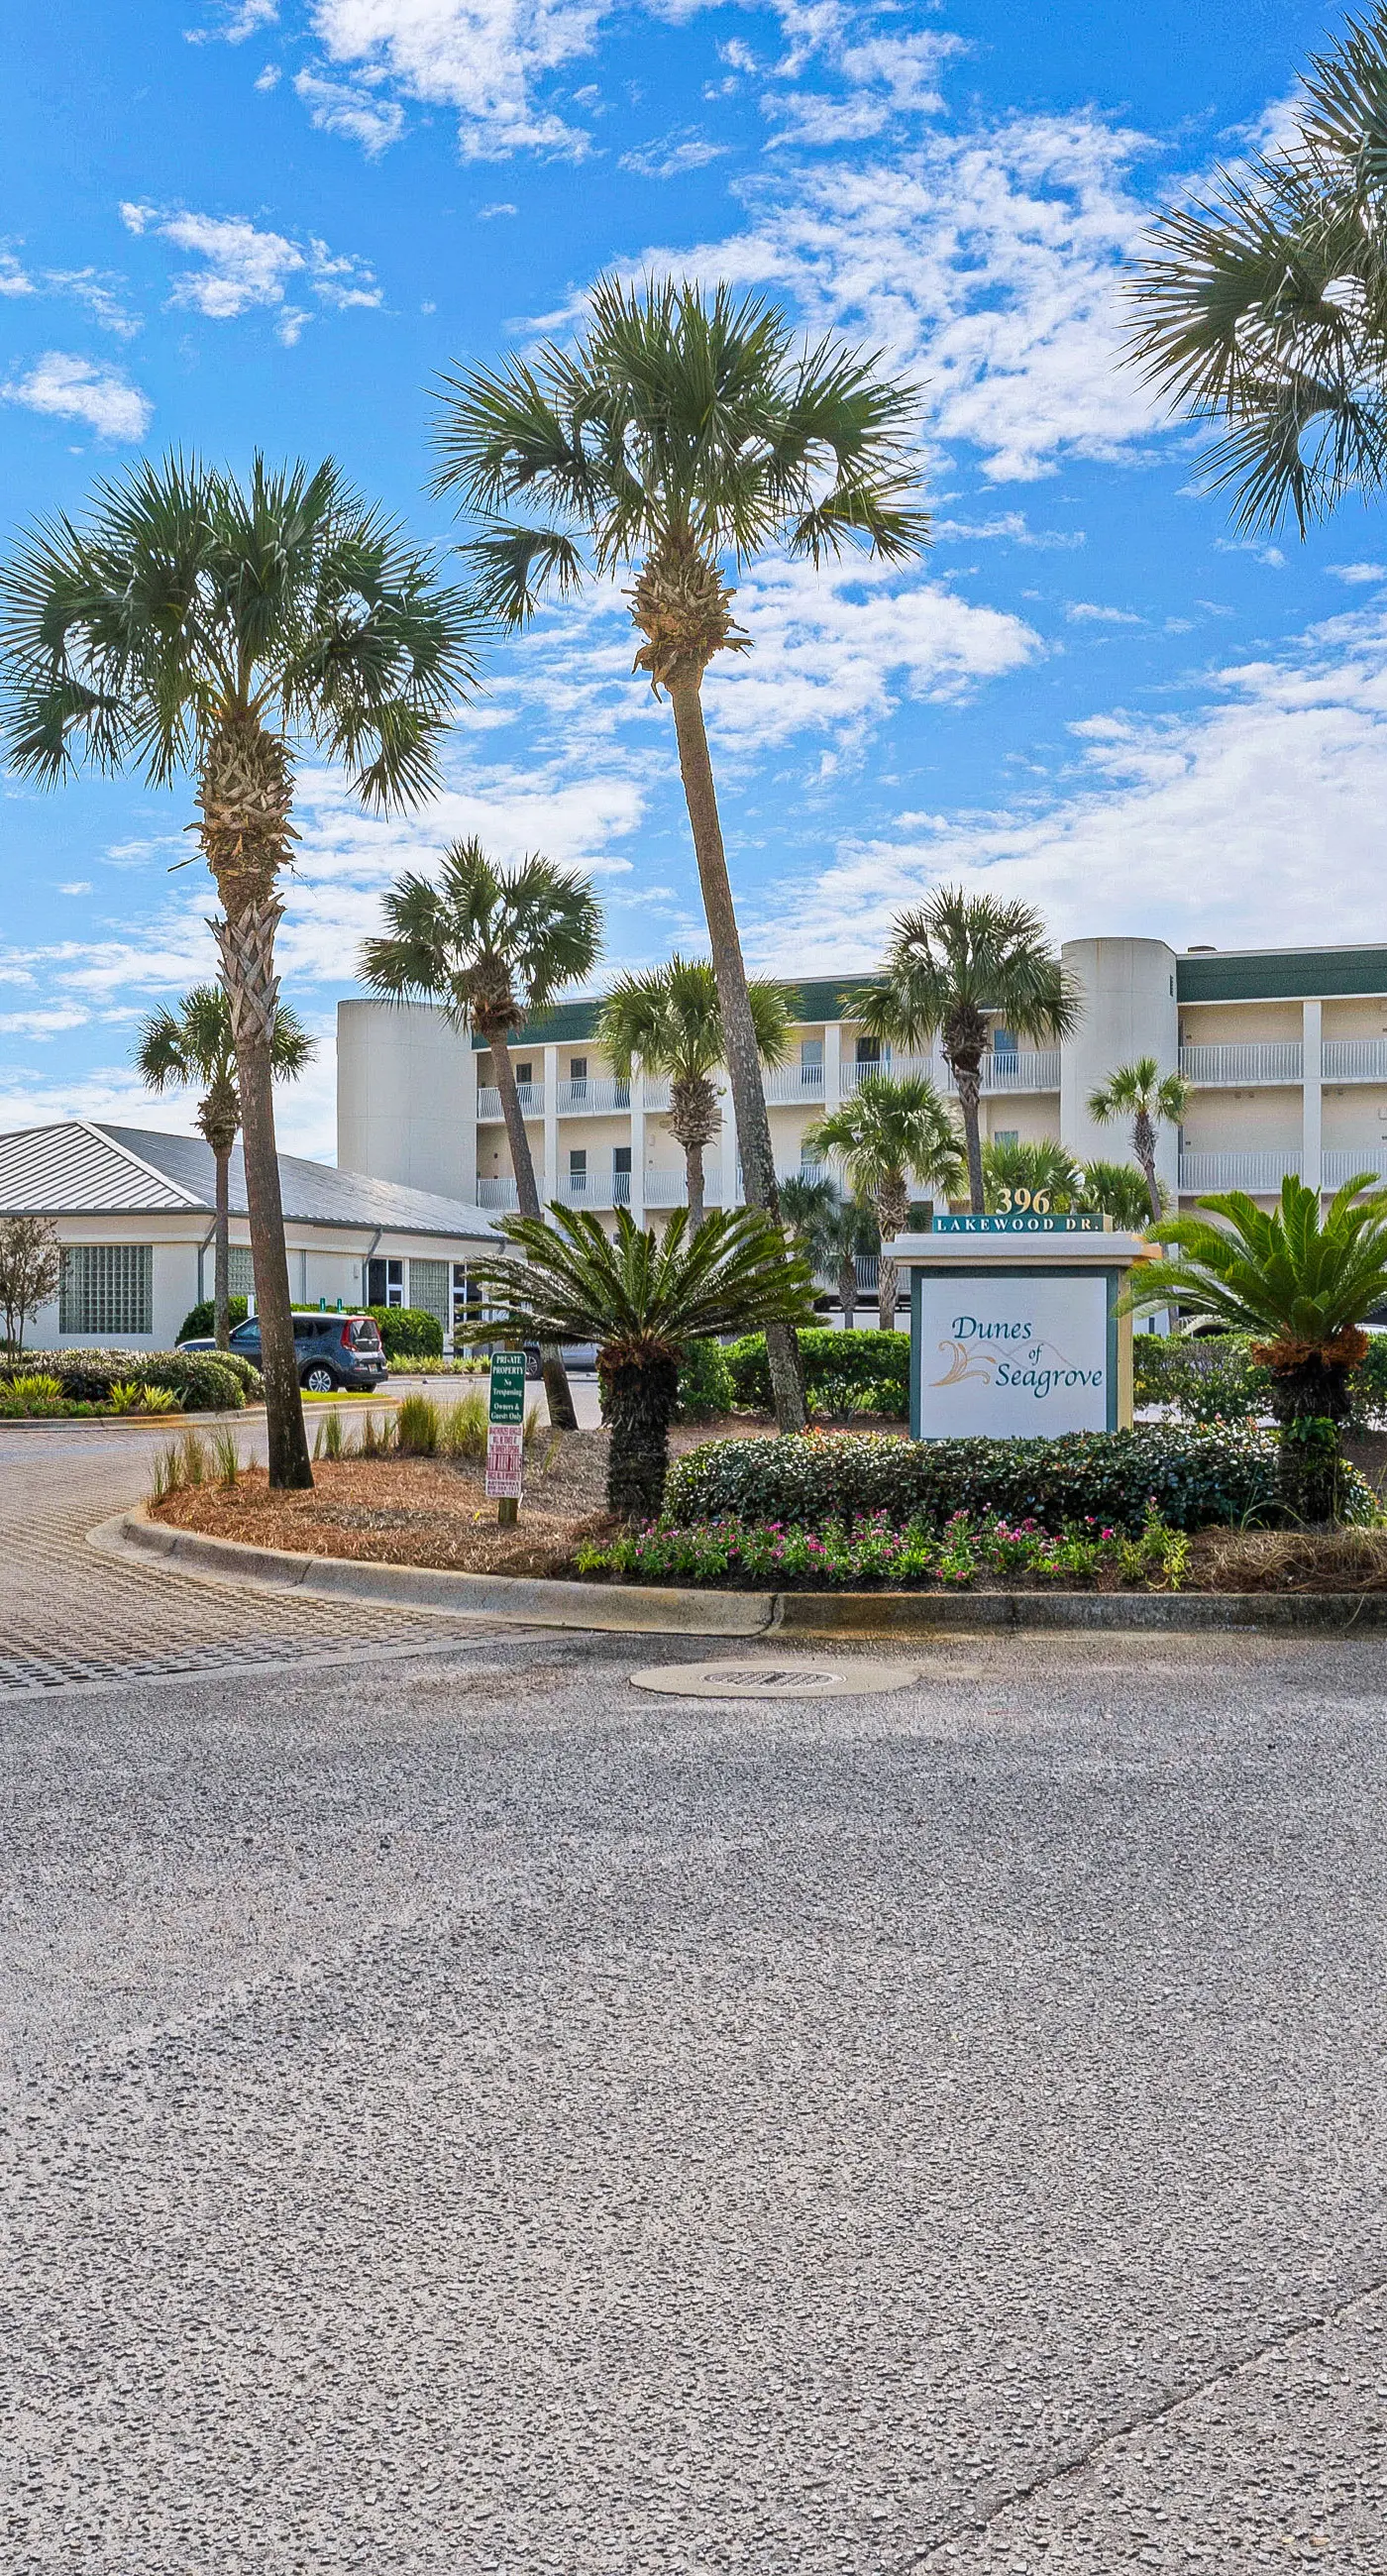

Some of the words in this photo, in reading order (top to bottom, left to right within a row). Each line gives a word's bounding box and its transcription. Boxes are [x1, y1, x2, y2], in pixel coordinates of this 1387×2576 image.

[996, 1188, 1051, 1215] 396
[936, 1219, 1054, 1232] LAKEWOOD
[1066, 1219, 1099, 1231] DR.
[951, 1316, 1032, 1340] Dunes
[1028, 1342, 1044, 1365] of
[492, 1366, 524, 1375] PROPERTY
[995, 1363, 1103, 1399] Seagrove
[493, 1402, 514, 1411] Owners
[508, 1412, 522, 1422] Only
